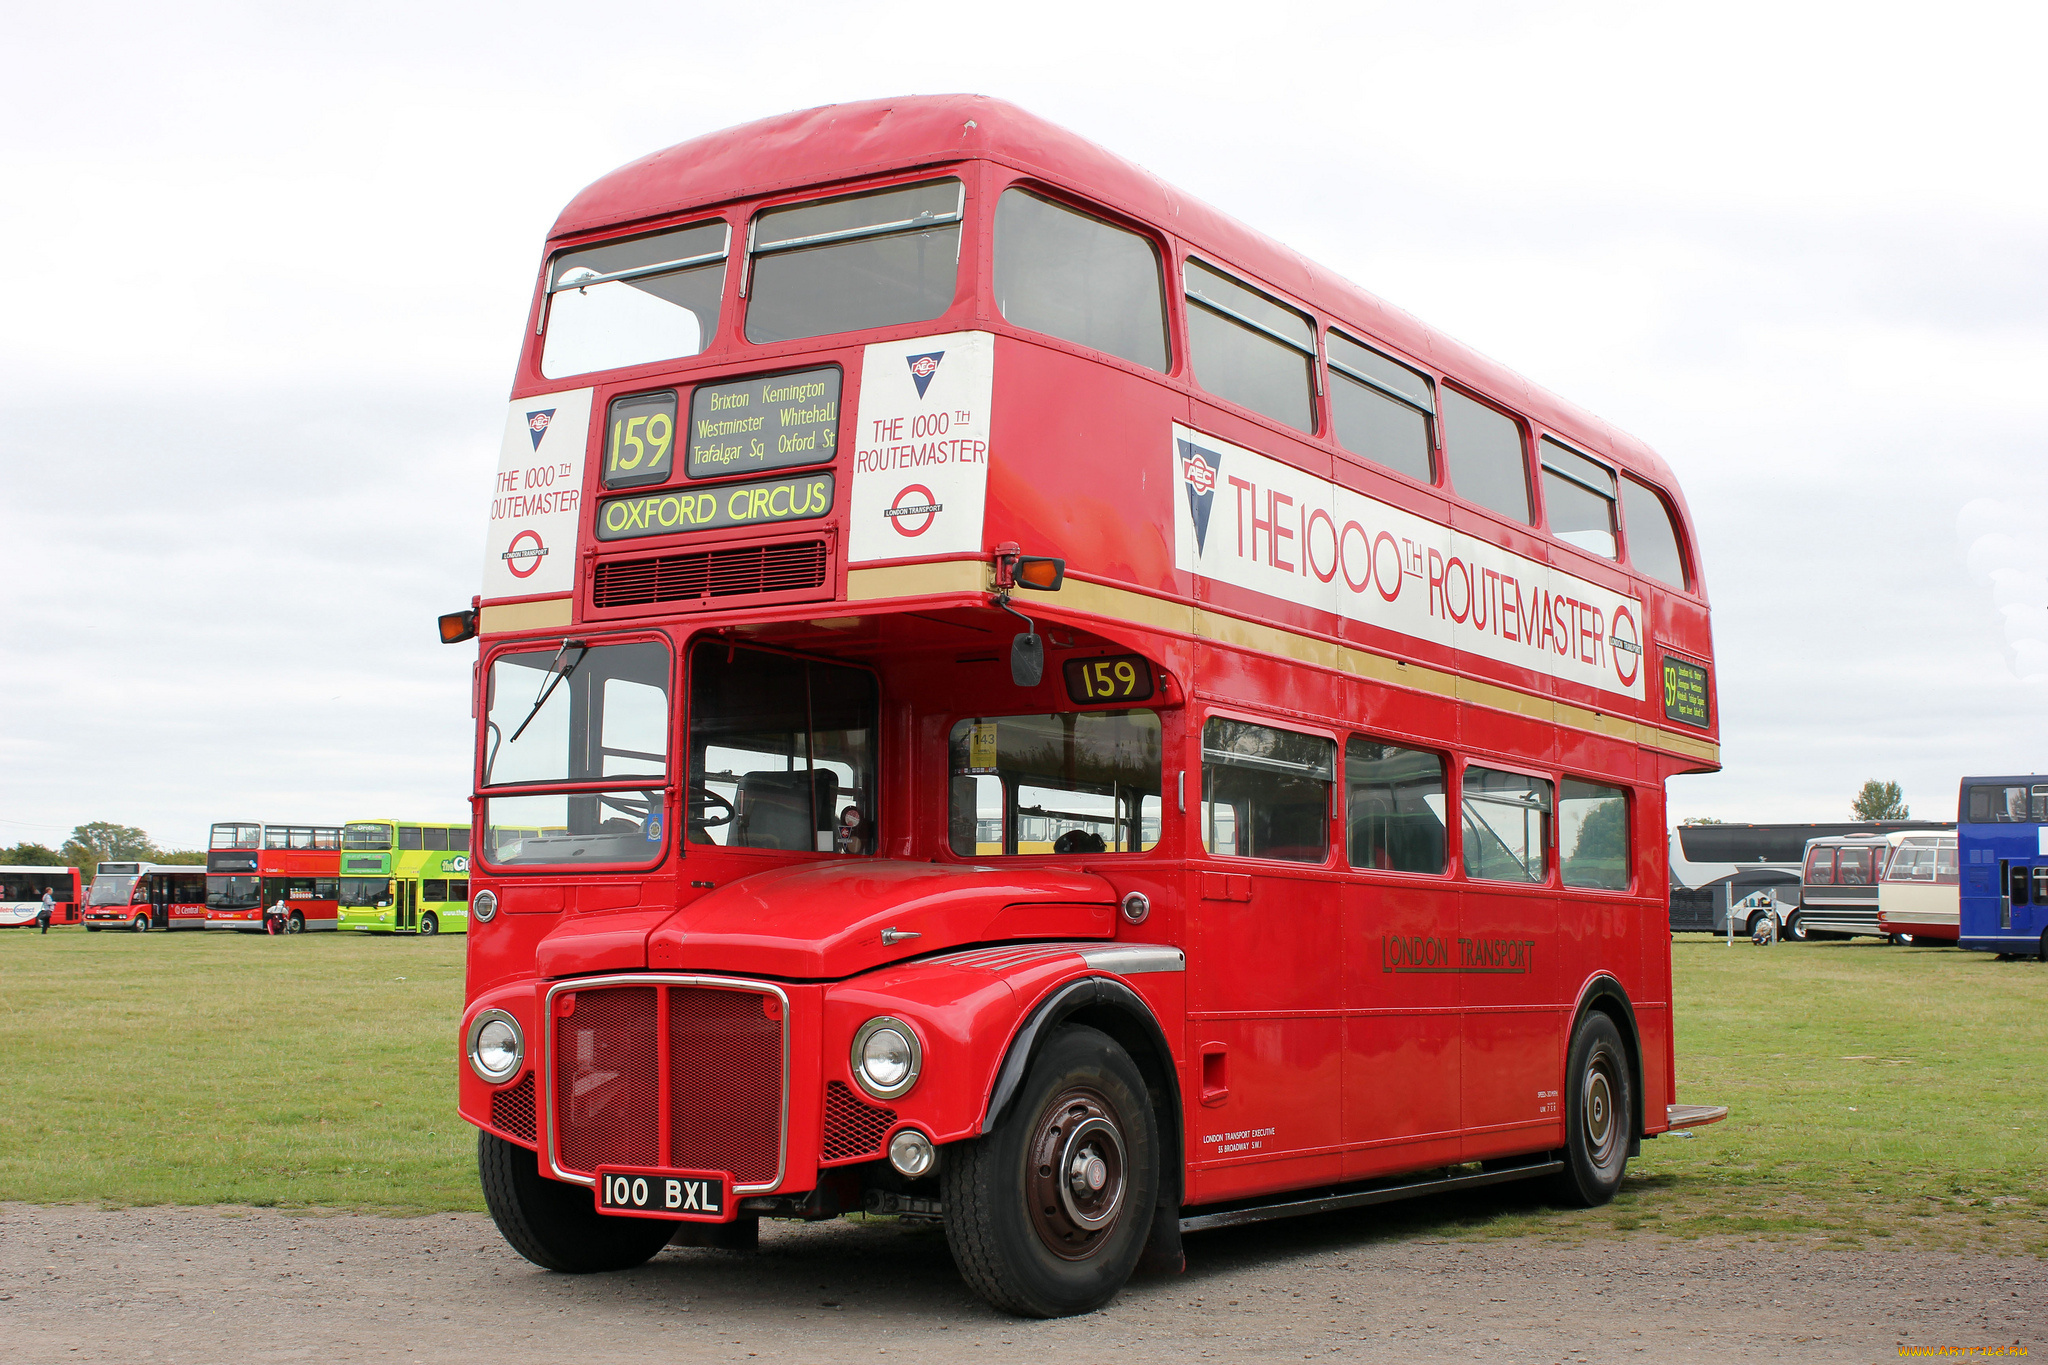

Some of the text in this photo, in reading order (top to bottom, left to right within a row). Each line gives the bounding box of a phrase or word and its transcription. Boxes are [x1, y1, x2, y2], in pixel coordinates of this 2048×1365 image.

[915, 362, 936, 372] AEC
[710, 382, 825, 411] Brixton Kennington
[697, 402, 837, 439] Westminster Whitehall
[873, 417, 904, 443] THE
[911, 412, 949, 439] 1000
[610, 413, 673, 472] 159
[694, 428, 836, 465] Trafalgar Sq Oxford St
[857, 439, 987, 474] ROUTEMASTER
[496, 470, 520, 493] THE
[525, 465, 555, 489] 1000
[1186, 466, 1213, 485] AEC
[491, 489, 580, 520] OUTEMASTER
[606, 482, 826, 532] OXFORD CIRCUS
[885, 504, 943, 517] LONDON TRANSPORT
[503, 548, 548, 560] LONDON TRANSPORT
[1228, 475, 1295, 573] THE
[1300, 503, 1403, 603] 1000
[1427, 547, 1607, 669] ROUTEMASTER
[1082, 661, 1136, 698] 159
[1664, 666, 1677, 707] 59
[974, 734, 995, 745] 143
[1382, 935, 1535, 974] LONDON TRANSPORT
[1203, 1127, 1276, 1144] LONDON TRANSPORT EXECUTIVE
[1224, 1142, 1249, 1153] BROADWAY
[605, 1175, 719, 1212] 100 BXL
